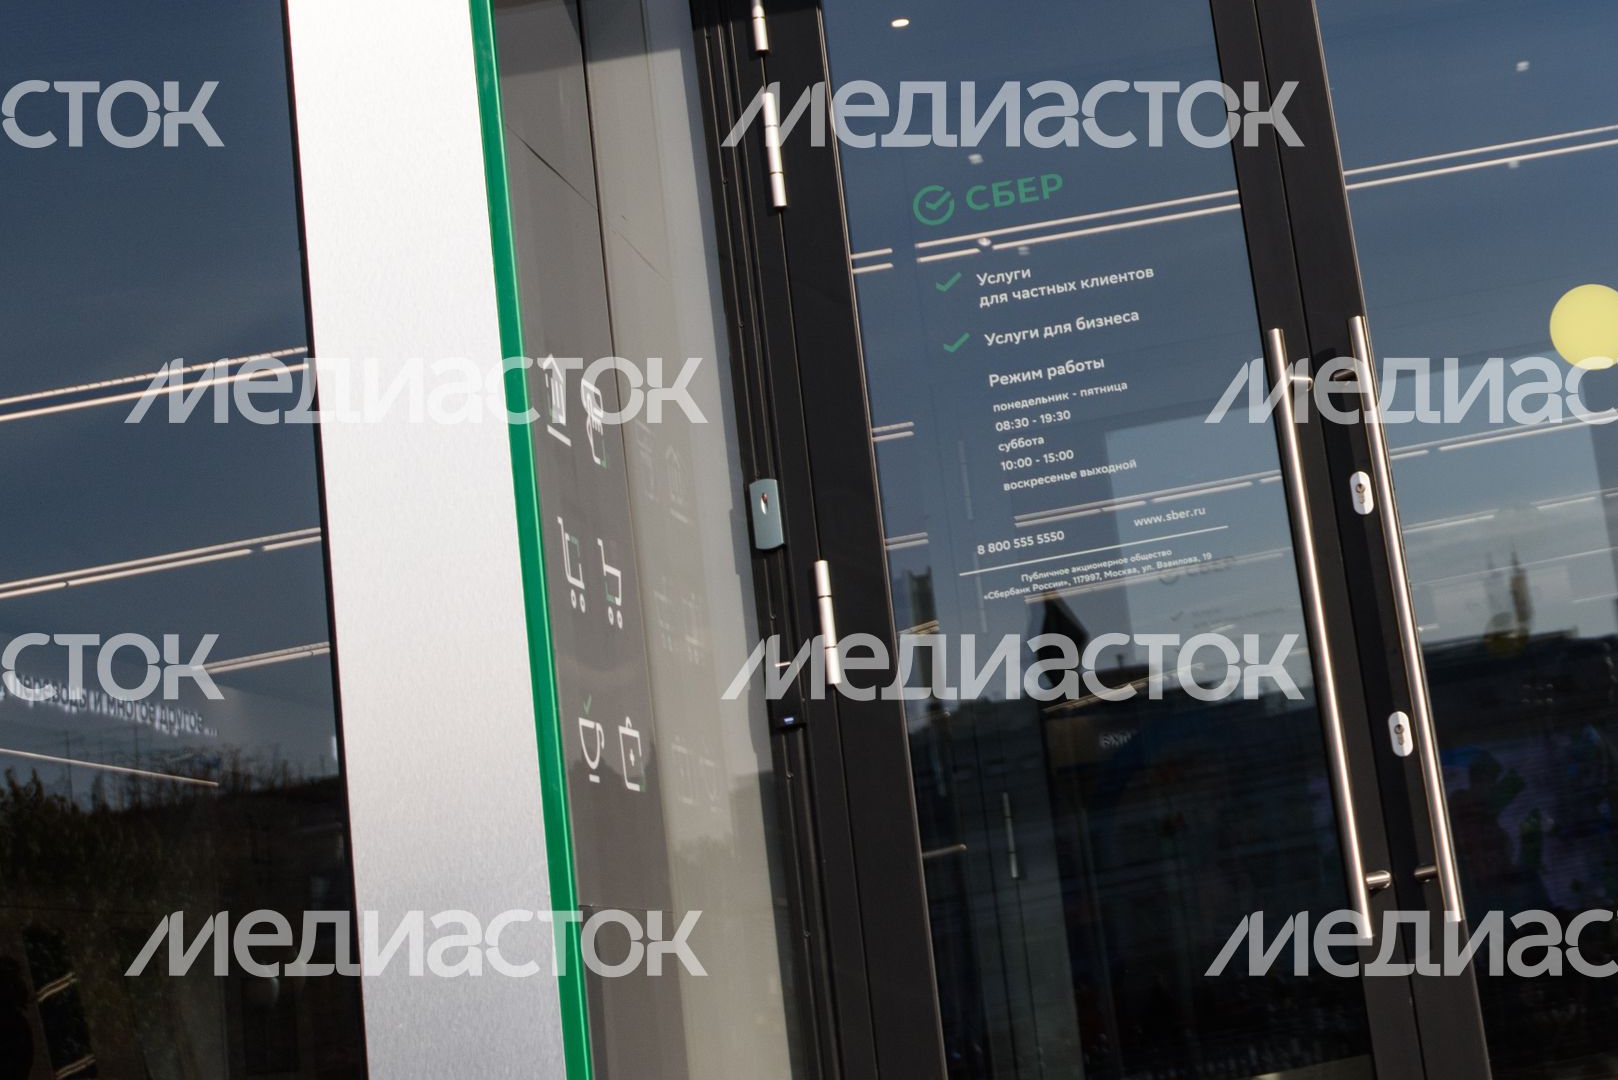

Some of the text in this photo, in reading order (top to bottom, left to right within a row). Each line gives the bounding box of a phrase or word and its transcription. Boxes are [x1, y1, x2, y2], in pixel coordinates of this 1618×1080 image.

[966, 173, 1064, 211] СБЕР
[976, 268, 1031, 287] Услуги
[979, 268, 1154, 308] для частных клиентов
[984, 311, 1139, 347] Услуги для бизнеса
[988, 358, 1105, 387] Режим работы
[992, 392, 1069, 412] понедельник
[1080, 381, 1128, 397] пятница
[995, 417, 1029, 432] 08:30
[1040, 410, 1071, 424] 19:30
[998, 436, 1045, 452] суббота
[1001, 457, 1032, 471] 10:00
[1043, 450, 1074, 464] 15:00
[1003, 459, 1137, 491] воскресенье выходной
[1133, 506, 1206, 527] www.sber.ru
[977, 530, 1065, 555] 8 800 555 5550
[983, 585, 1031, 601] «Сбербанк
[1104, 565, 1140, 579] Москва,
[1142, 563, 1155, 574] ул.
[1156, 555, 1201, 569] Вавилова,
[1203, 551, 1213, 561] 19
[1021, 549, 1173, 583] Публичное акционерное общество
